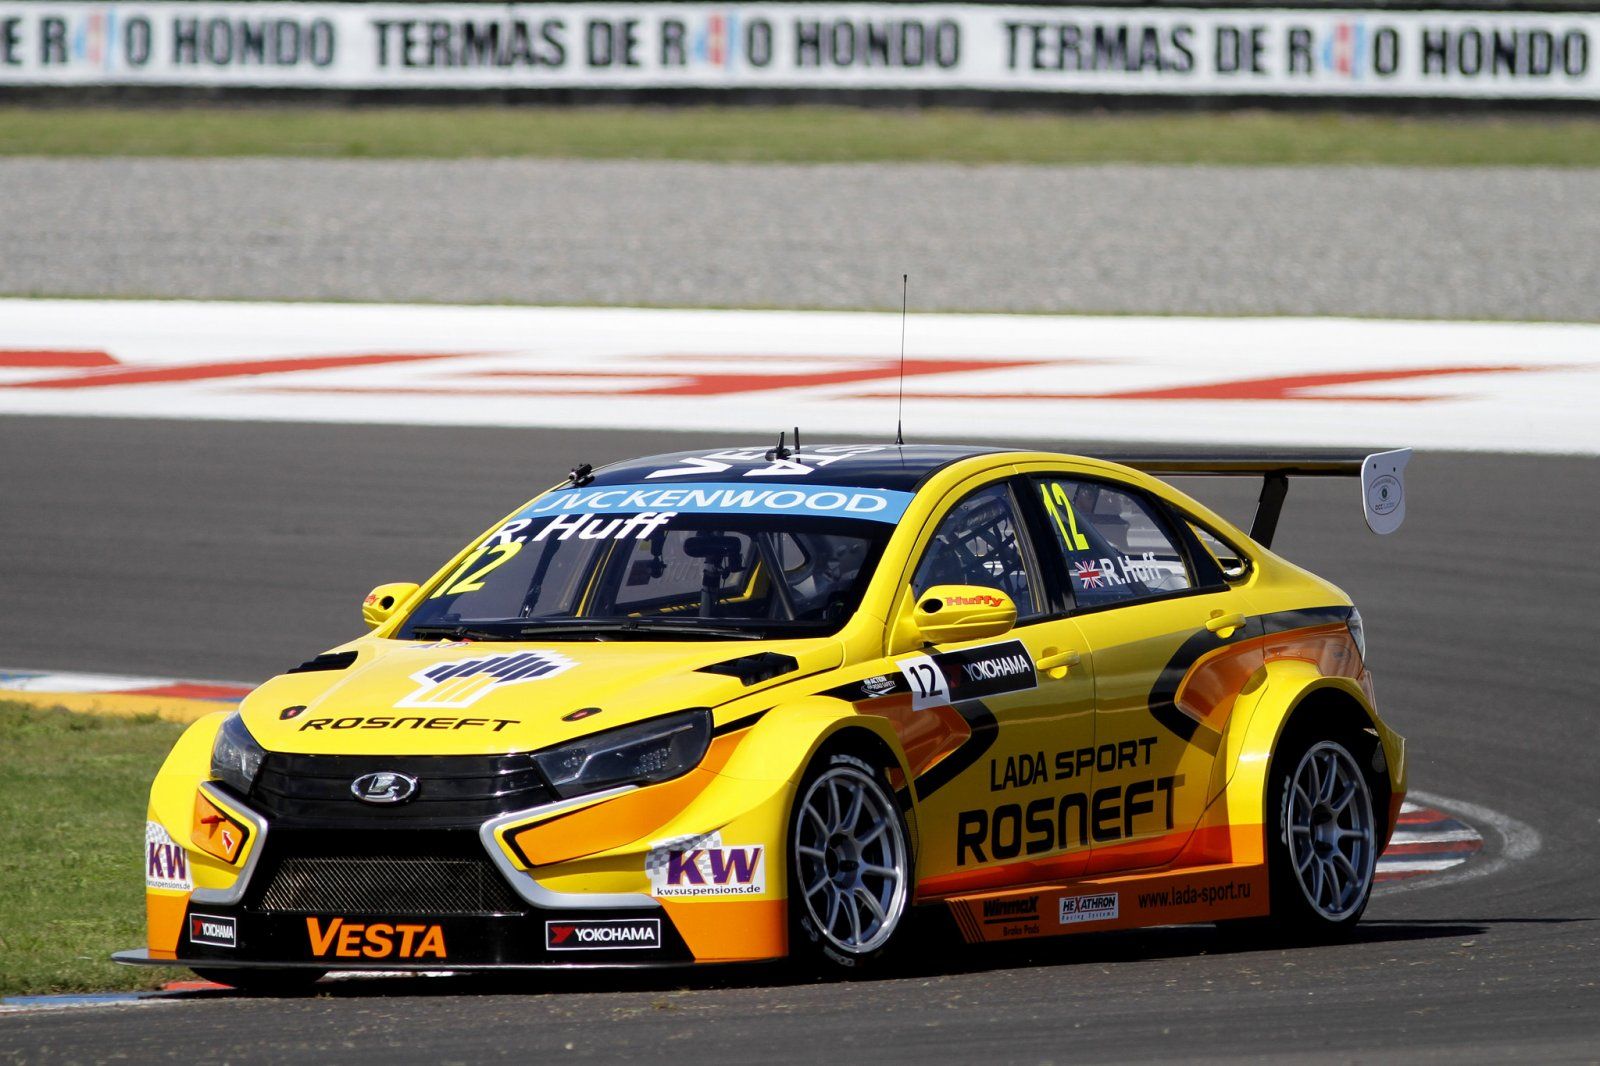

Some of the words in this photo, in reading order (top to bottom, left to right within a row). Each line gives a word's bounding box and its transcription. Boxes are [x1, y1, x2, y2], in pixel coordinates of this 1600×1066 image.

[39, 17, 152, 65] RO
[173, 19, 336, 67] HONDO
[372, 20, 567, 68] TERMAS
[586, 20, 642, 67] DE
[661, 20, 772, 68] RO
[795, 20, 961, 68] HONDO
[1003, 23, 1195, 73] TERMAS
[1215, 25, 1269, 74] DE
[1289, 24, 1399, 77] RO
[1422, 29, 1589, 77] HONDO
[533, 489, 888, 513] JVCKENWOOD
[1040, 482, 1090, 552] 12
[430, 541, 523, 599] 12
[1099, 551, 1162, 586] R.Huff
[945, 595, 1005, 608] Huffy
[908, 663, 943, 699] 12
[963, 654, 1031, 682] YOKOHAMA
[298, 716, 522, 732] ROSNEFT
[990, 751, 1048, 792] LADA
[1055, 737, 1158, 780] SPORT
[956, 774, 1186, 866] ROSNEFT
[149, 842, 186, 879] KW
[666, 847, 764, 885] KW
[656, 885, 761, 897] kwsuspensions.de
[1063, 897, 1116, 912] HEXATHRON
[1138, 881, 1251, 909] www.lada-sport.ru
[201, 924, 234, 939] YOKOHAMA
[305, 917, 447, 959] VESTA
[574, 927, 655, 941] YOKOHAMA
